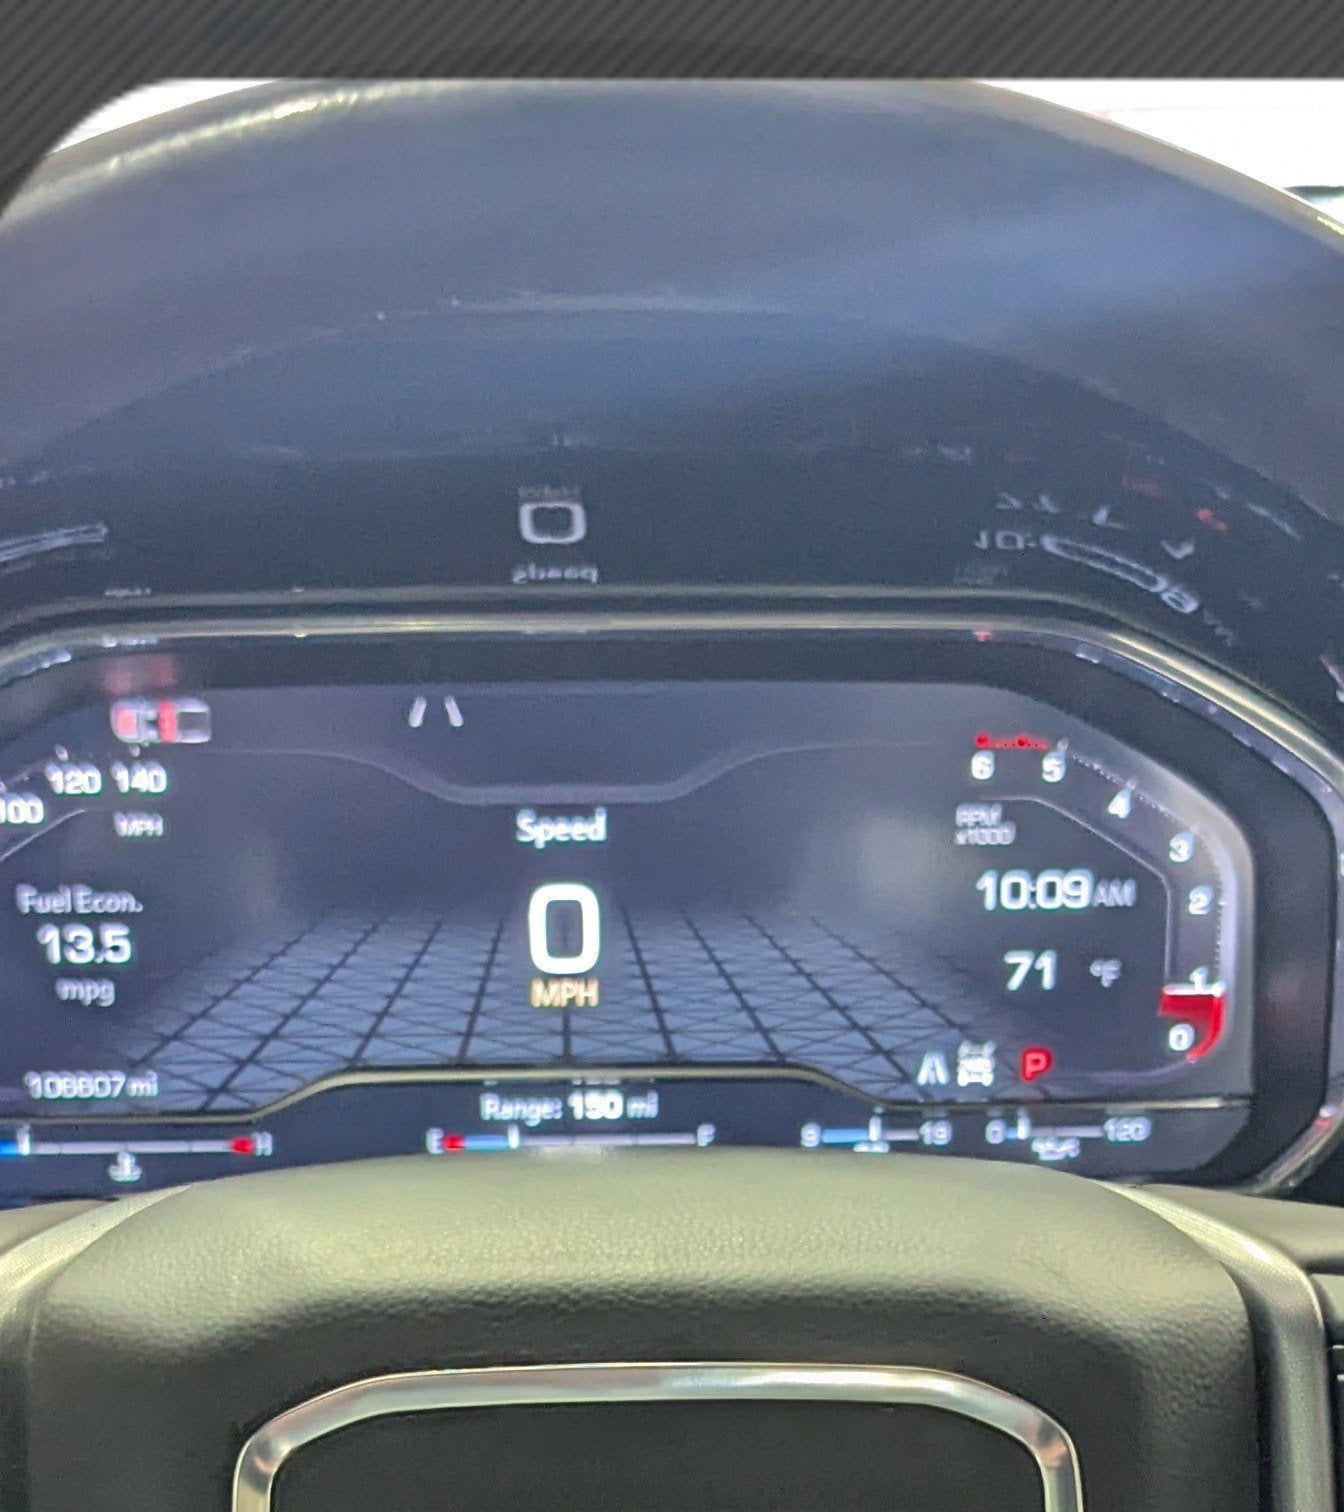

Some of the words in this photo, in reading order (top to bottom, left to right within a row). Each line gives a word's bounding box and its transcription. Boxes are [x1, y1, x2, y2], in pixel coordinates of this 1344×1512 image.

[45, 763, 102, 795] 120
[110, 761, 167, 793] 140
[971, 750, 995, 780] 6
[1042, 752, 1066, 782] 5
[516, 807, 607, 849] Speed
[1169, 832, 1195, 863] 3
[15, 883, 72, 914] Fuel
[73, 884, 144, 914] Econ.
[975, 868, 1094, 912] 10:09
[1188, 886, 1215, 916] 2
[36, 923, 133, 965] 13.5
[528, 882, 601, 975] 0
[1005, 950, 1058, 991] 71
[56, 979, 116, 1007] mpg
[530, 977, 600, 1009] MPH
[1020, 1046, 1054, 1083] P
[480, 1092, 563, 1126] Range:
